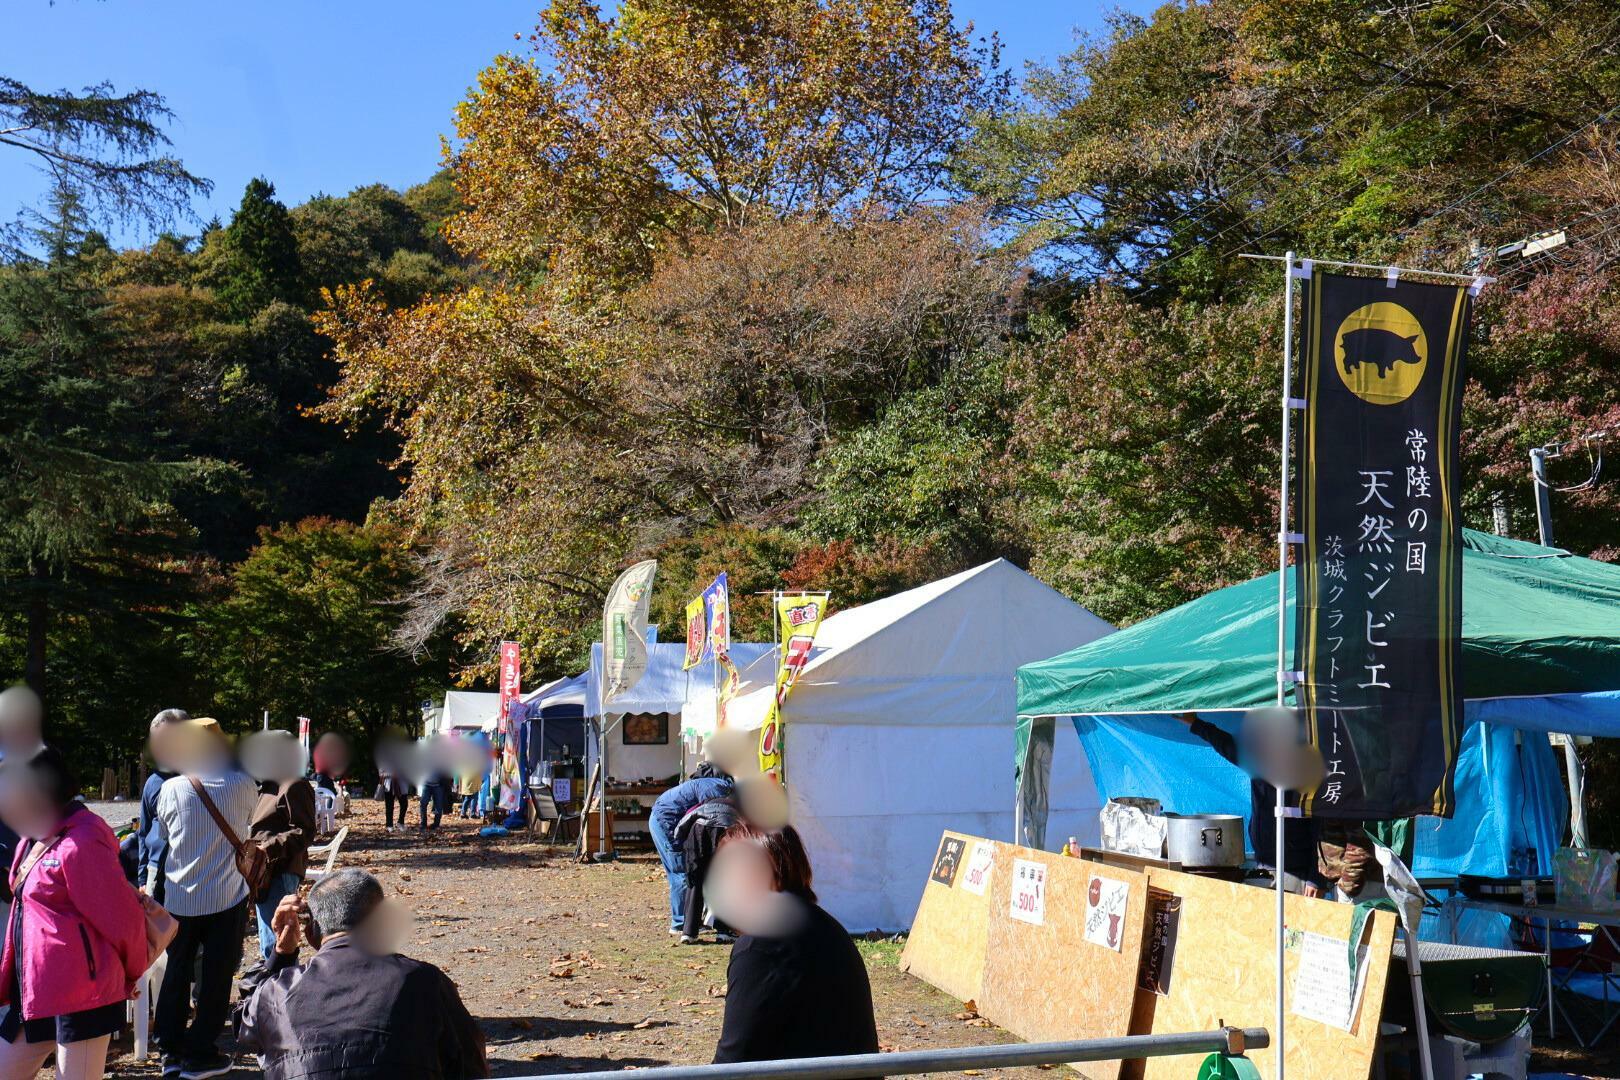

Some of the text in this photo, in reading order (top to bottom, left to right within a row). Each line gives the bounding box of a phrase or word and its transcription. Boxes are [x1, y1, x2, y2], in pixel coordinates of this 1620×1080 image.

[1405, 428, 1432, 574] 常陸の国
[1356, 469, 1395, 689] 天然ジビエ
[1321, 535, 1347, 804] 茨城クラフトミート工房
[969, 868, 983, 886] 500
[1018, 892, 1035, 913] 500
